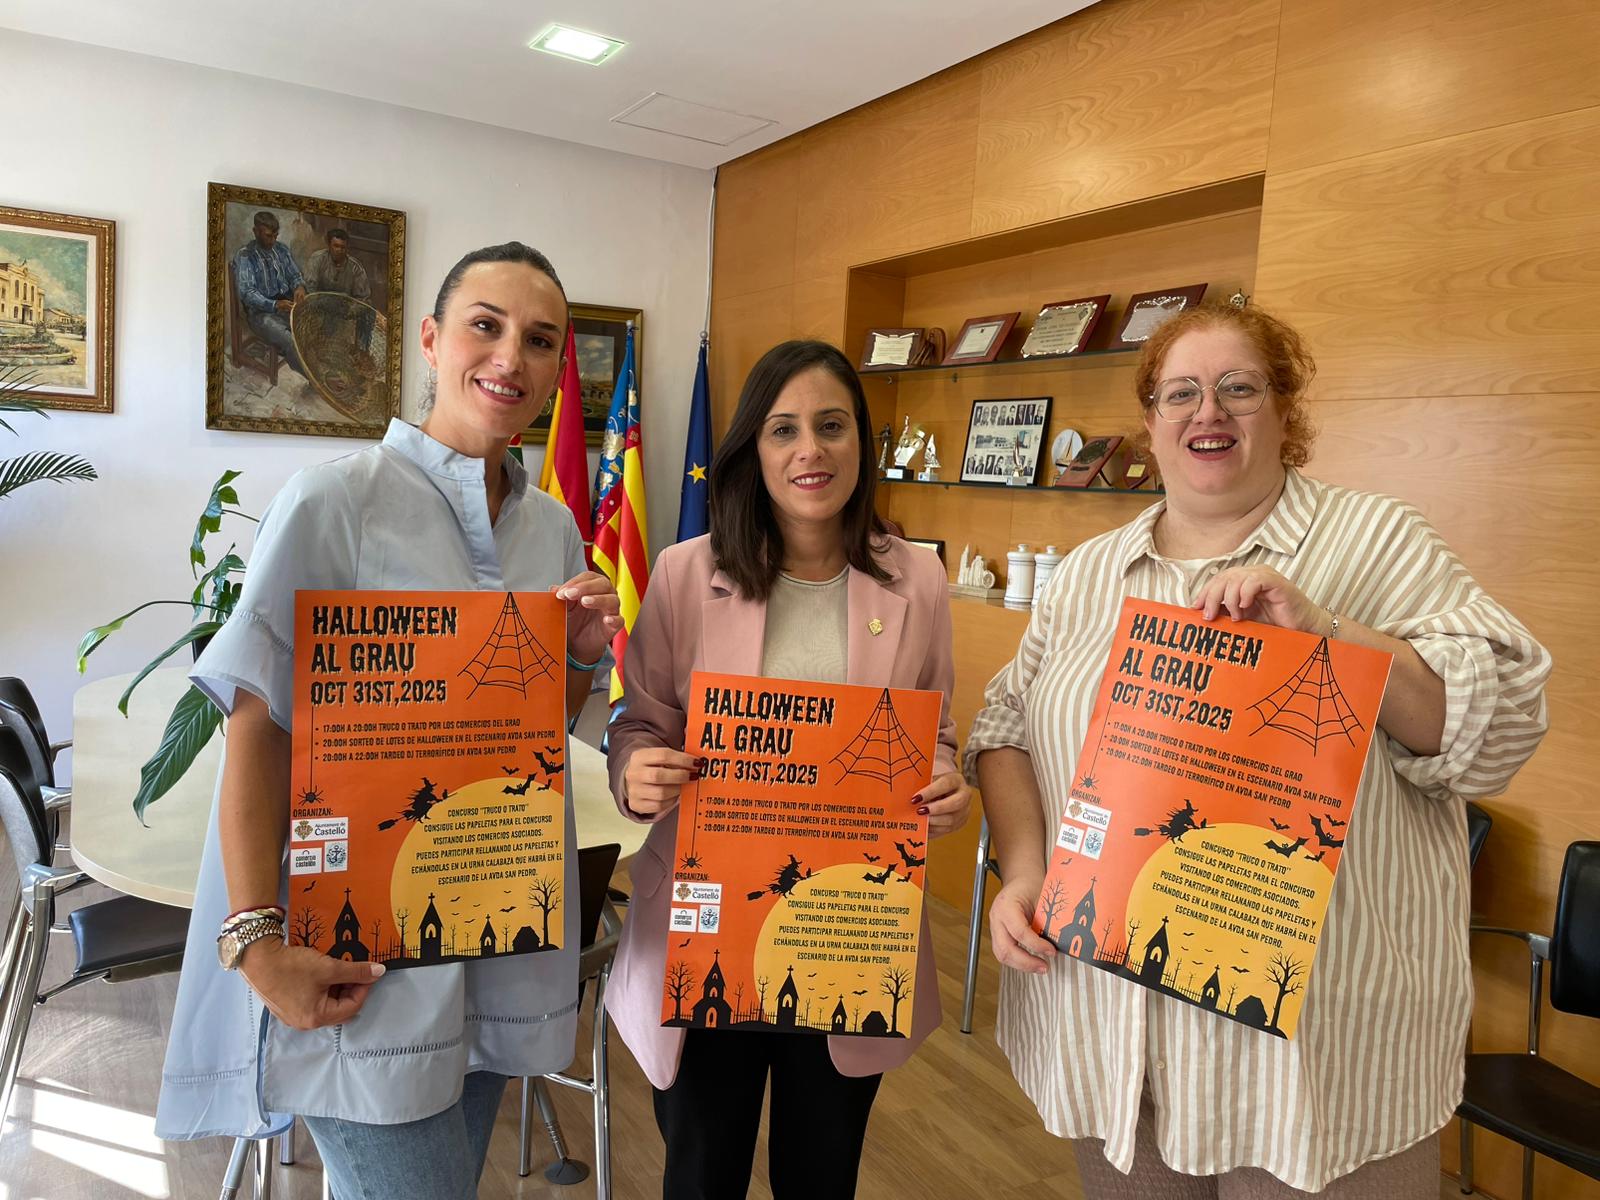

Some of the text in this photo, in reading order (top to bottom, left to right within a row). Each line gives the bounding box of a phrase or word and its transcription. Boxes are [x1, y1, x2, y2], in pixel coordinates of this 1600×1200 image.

[313, 605, 457, 638] HALLOWEEN
[1131, 614, 1263, 668] HALLOWEEN
[311, 642, 415, 675] AL GRAU
[1119, 646, 1213, 694] AL GRAU
[311, 679, 447, 707] OCT 31ST,2025
[705, 687, 835, 726] HALLOWEEN
[1112, 680, 1233, 732] OCT 31ST,2025
[700, 721, 793, 758] AL GRAU
[1131, 727, 1136, 735] A
[1159, 734, 1178, 746] TRUCO
[1178, 739, 1184, 748] O
[1185, 741, 1204, 754] TRATO
[1204, 747, 1218, 757] POR
[1218, 751, 1231, 762] LOS
[1232, 755, 1269, 772] COMERCIOS
[1270, 766, 1282, 776] DEL
[699, 756, 818, 787] OCT 31ST,2025
[1126, 753, 1131, 761] A
[1154, 761, 1176, 775] TARDEO
[1176, 768, 1185, 777] DJ
[1185, 770, 1225, 789] TERRORÍFICO
[1225, 782, 1235, 792] EN
[1235, 786, 1253, 798] AVDA
[1253, 791, 1268, 802] SAN
[1269, 795, 1291, 809] PEDRO
[1130, 740, 1152, 753] SORTEO
[1152, 747, 1161, 756] DE
[1161, 749, 1180, 761] LOTES
[1180, 754, 1189, 764] DE
[1189, 758, 1226, 774] HALLOWEEN
[1227, 768, 1237, 778] EN
[1237, 771, 1245, 781] EL
[1247, 774, 1283, 791] ESCENARIO
[1284, 785, 1301, 797] AVDA
[1303, 790, 1318, 801] SAN
[1318, 794, 1342, 808] PEDRO
[293, 808, 333, 817] ORGANIZAN:
[424, 815, 552, 832] CONSIGUE LAS PAPELETAS PARA EL CONCURSO
[448, 808, 478, 817] CONCURSO
[503, 805, 507, 813] O
[727, 811, 749, 820] SORTEO
[750, 813, 758, 821] DE
[759, 813, 777, 822] LOTES
[778, 814, 785, 822] DE
[787, 815, 820, 824] HALLOWEEN
[821, 817, 829, 825] EN
[830, 817, 837, 825] EL
[838, 818, 869, 828] ESCENARIO
[870, 820, 885, 829] AVDA
[886, 821, 898, 829] SAN
[899, 822, 918, 831] PEDRO
[433, 829, 543, 845] VISITANDO LOS COMERCIOS ASOCIADOS.
[726, 824, 730, 832] A
[754, 826, 776, 835] TARDEO
[776, 827, 783, 835] DJ
[785, 828, 821, 838] TERRORÍFICO
[822, 830, 830, 838] EN
[831, 831, 845, 839] AVDA
[847, 832, 858, 840] SAN
[859, 833, 878, 841] PEDRO
[411, 853, 562, 874] ECHÁNDOLAS EN LA URNA CALABAZA QUE HABRÁ EN EL
[416, 851, 439, 860] PUEDES
[440, 848, 474, 858] PARTICIPAR
[475, 844, 511, 854] RELLANANDO
[512, 843, 523, 851] LAS
[524, 841, 554, 850] PAPELETAS
[1201, 841, 1234, 858] CONCURSO
[1260, 860, 1266, 868] O
[438, 868, 537, 885] ESCENARIO DE LA AVDA SAN PEDRO.
[1174, 847, 1315, 898] CONSIGUE LAS PAPELETAS PARA EL CONCURSO
[1180, 863, 1299, 909] VISITANDO LOS COMERCIOS ASOCIADOS.
[1152, 882, 1316, 944] ECHÁNDOLAS EN LA URNA CALABAZA QUE HABRÁ EN EL
[1160, 870, 1316, 929] PUEDES PARTICIPAR RELLANANDO LAS PAPELETAS Y
[1175, 905, 1282, 948] ESCENARIO DE LA AVDA SAN PEDRO.
